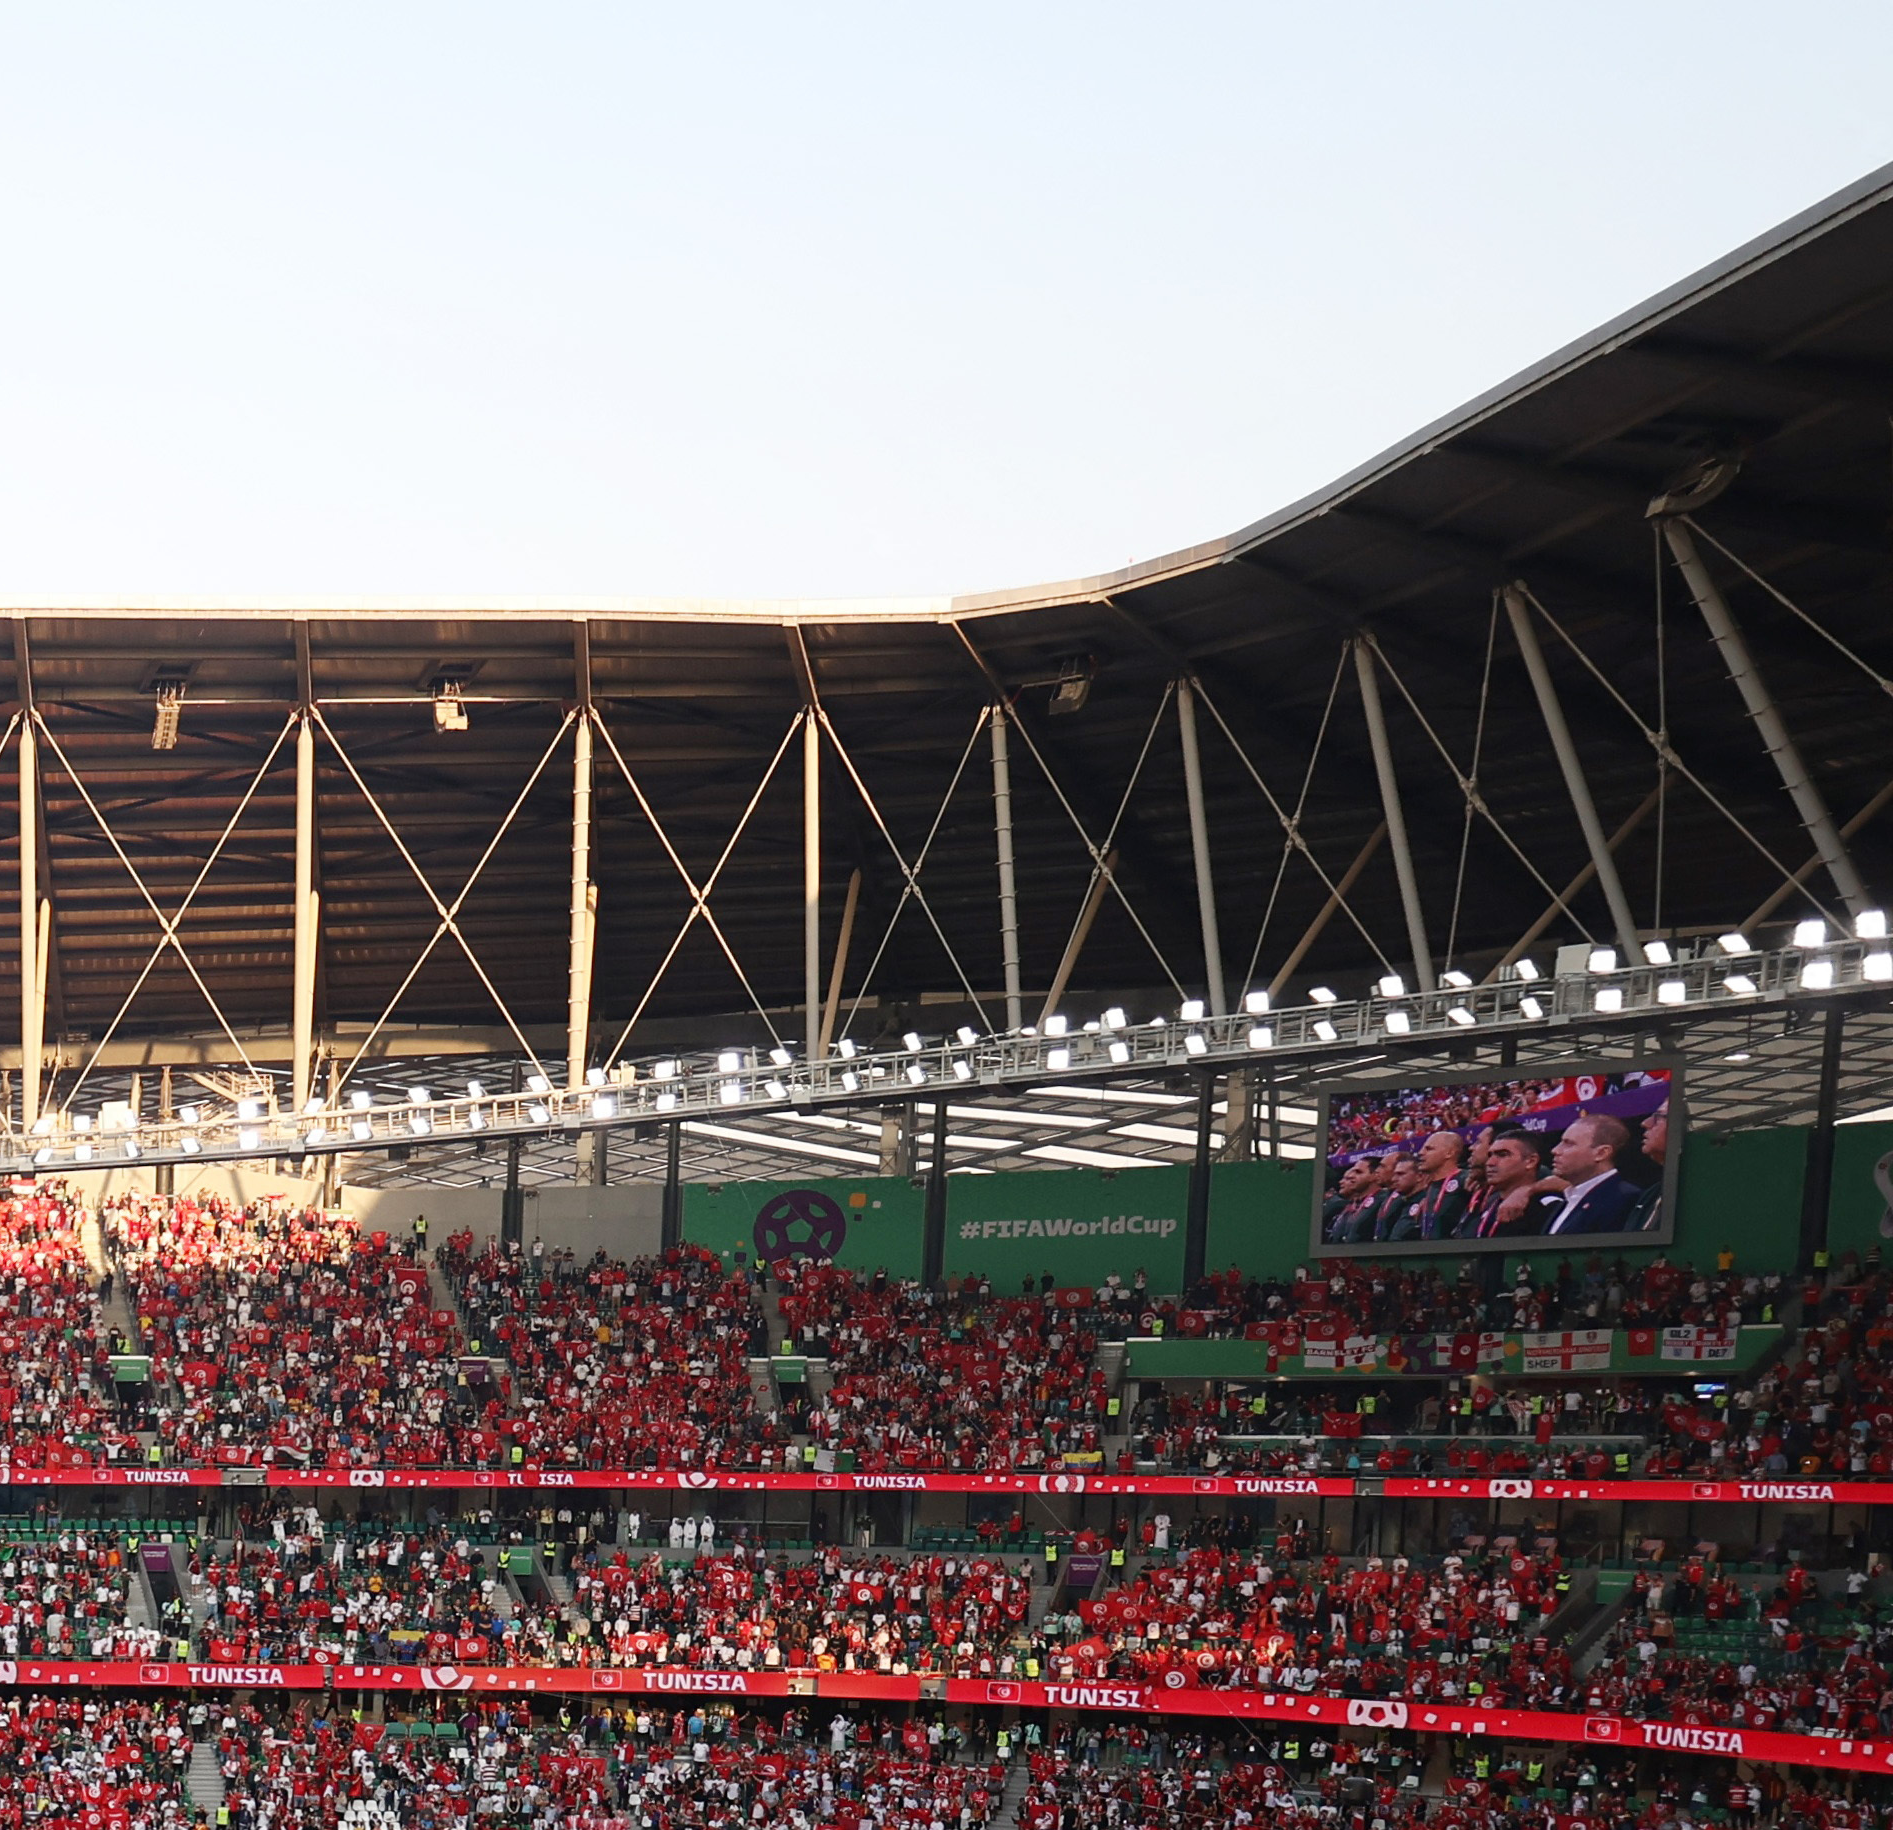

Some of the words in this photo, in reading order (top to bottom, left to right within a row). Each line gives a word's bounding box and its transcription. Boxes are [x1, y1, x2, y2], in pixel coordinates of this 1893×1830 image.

[960, 1215, 1177, 1239] #FIFAWorldCup
[1306, 1347, 1359, 1356] BARNSLEY
[125, 1471, 189, 1482] TUNISIA
[853, 1476, 926, 1488] TUNISIA
[1235, 1480, 1318, 1492] TUNISIA
[1740, 1485, 1833, 1499] TUNISIA
[188, 1667, 283, 1684] TUNISIA
[643, 1673, 746, 1691] TUNISIA
[1643, 1725, 1742, 1753] TUNISIA
